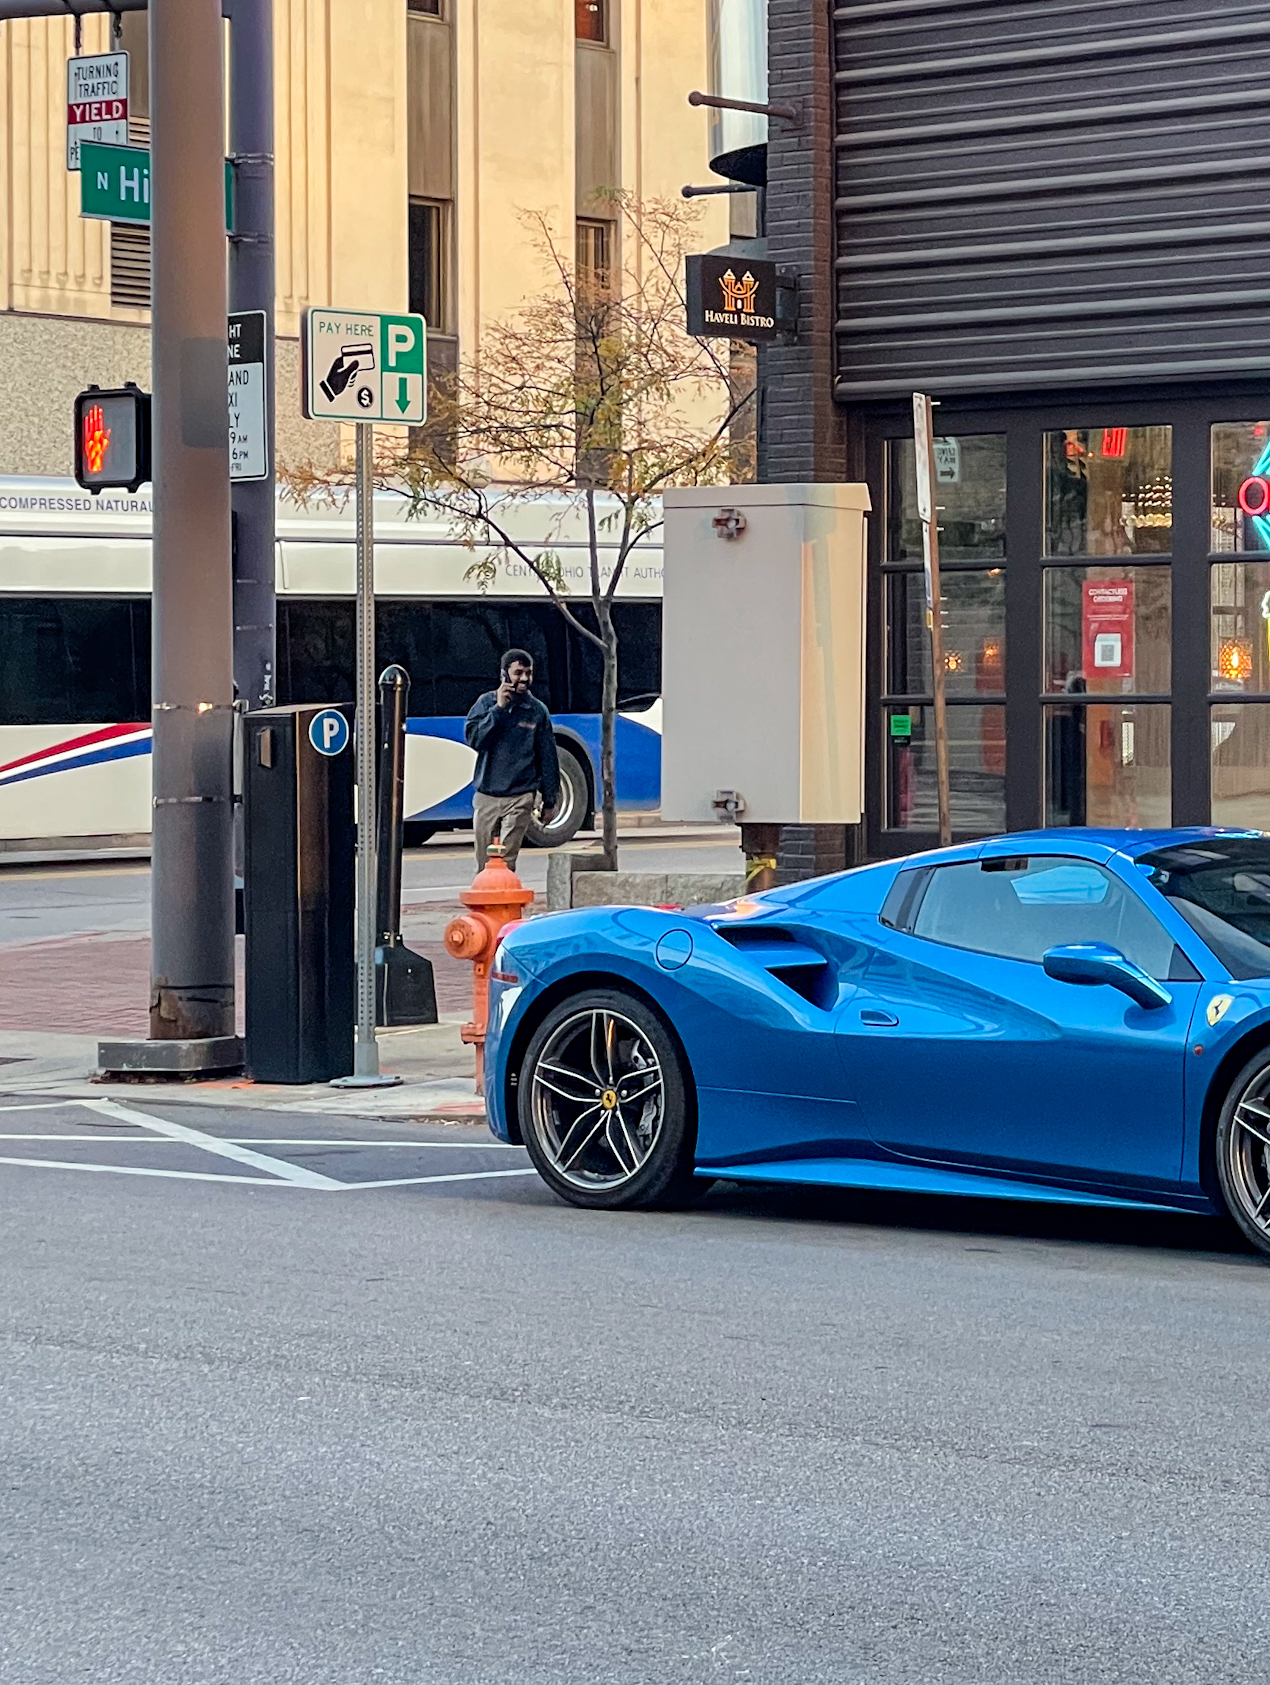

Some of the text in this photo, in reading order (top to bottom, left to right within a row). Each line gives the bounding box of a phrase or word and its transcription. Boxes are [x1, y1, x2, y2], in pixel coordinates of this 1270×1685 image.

[76, 62, 119, 81] TURNING
[78, 81, 118, 98] TRAFFIC
[73, 101, 123, 122] YIELD
[93, 127, 103, 140] TO
[97, 166, 149, 203] N Hi
[705, 310, 774, 328] HAVELI BISTRO
[319, 321, 374, 337] PAY HERE
[388, 324, 415, 367] P
[0, 496, 154, 512] COMPRESSED NATURAL
[323, 718, 340, 749] P
